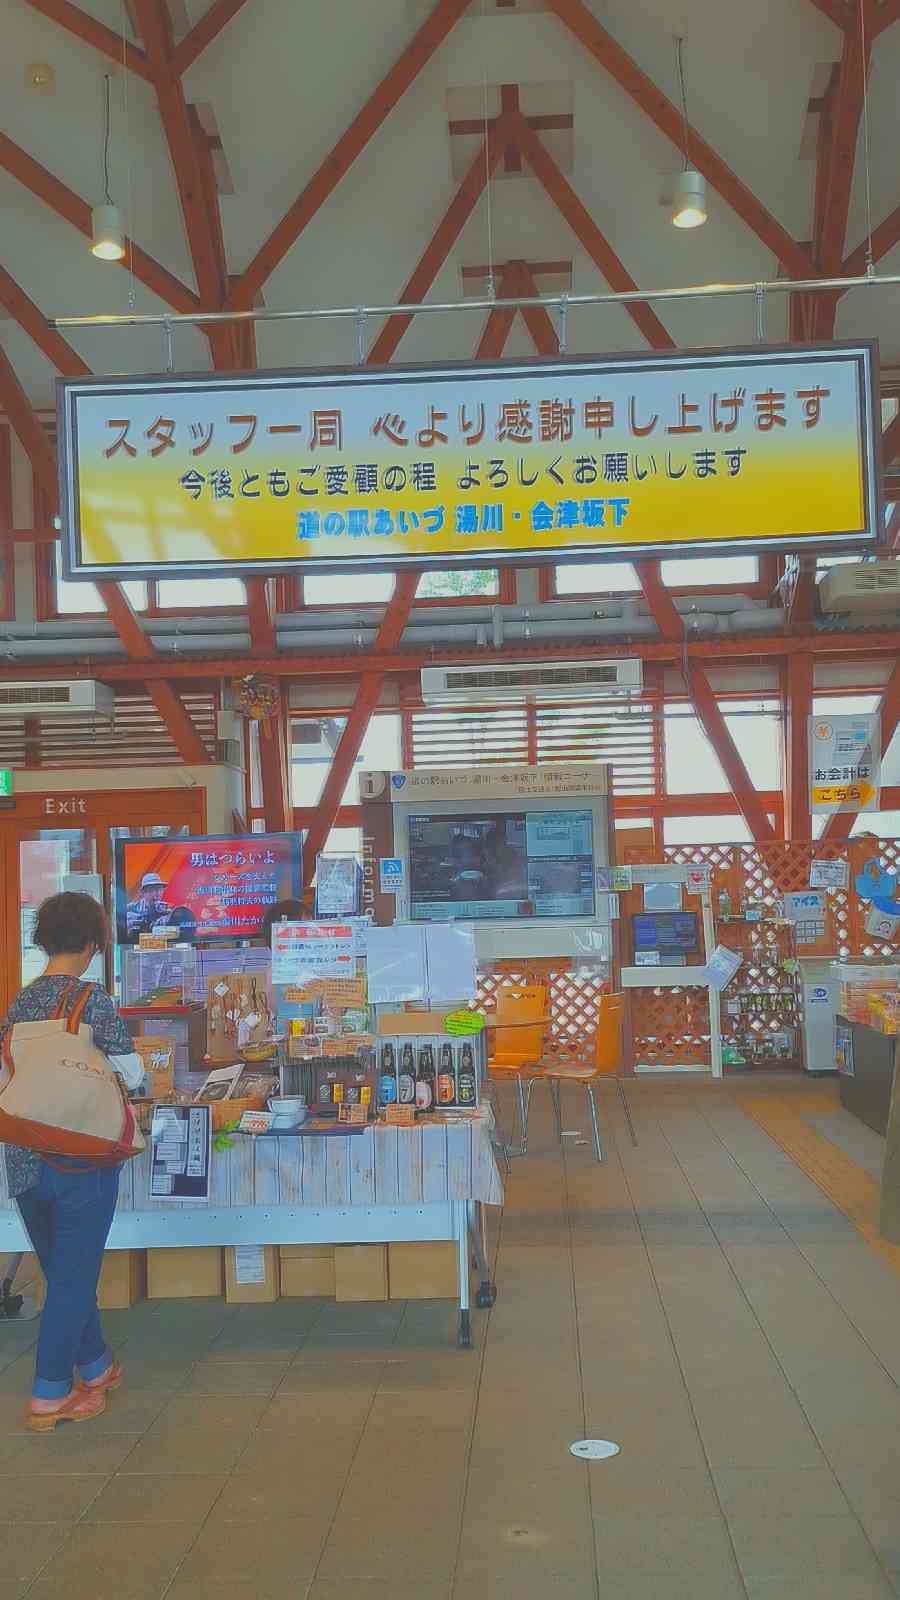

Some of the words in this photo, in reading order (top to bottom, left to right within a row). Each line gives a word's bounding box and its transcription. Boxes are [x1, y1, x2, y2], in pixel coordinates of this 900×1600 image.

[371, 384, 832, 449] 心より感謝申し上げます
[180, 462, 438, 500] 今後ともご愛顧の程
[456, 447, 748, 490] よろしくお願いします
[296, 504, 444, 540] 道の駅あいづ
[45, 798, 87, 814] Exit
[822, 787, 861, 801] こちら
